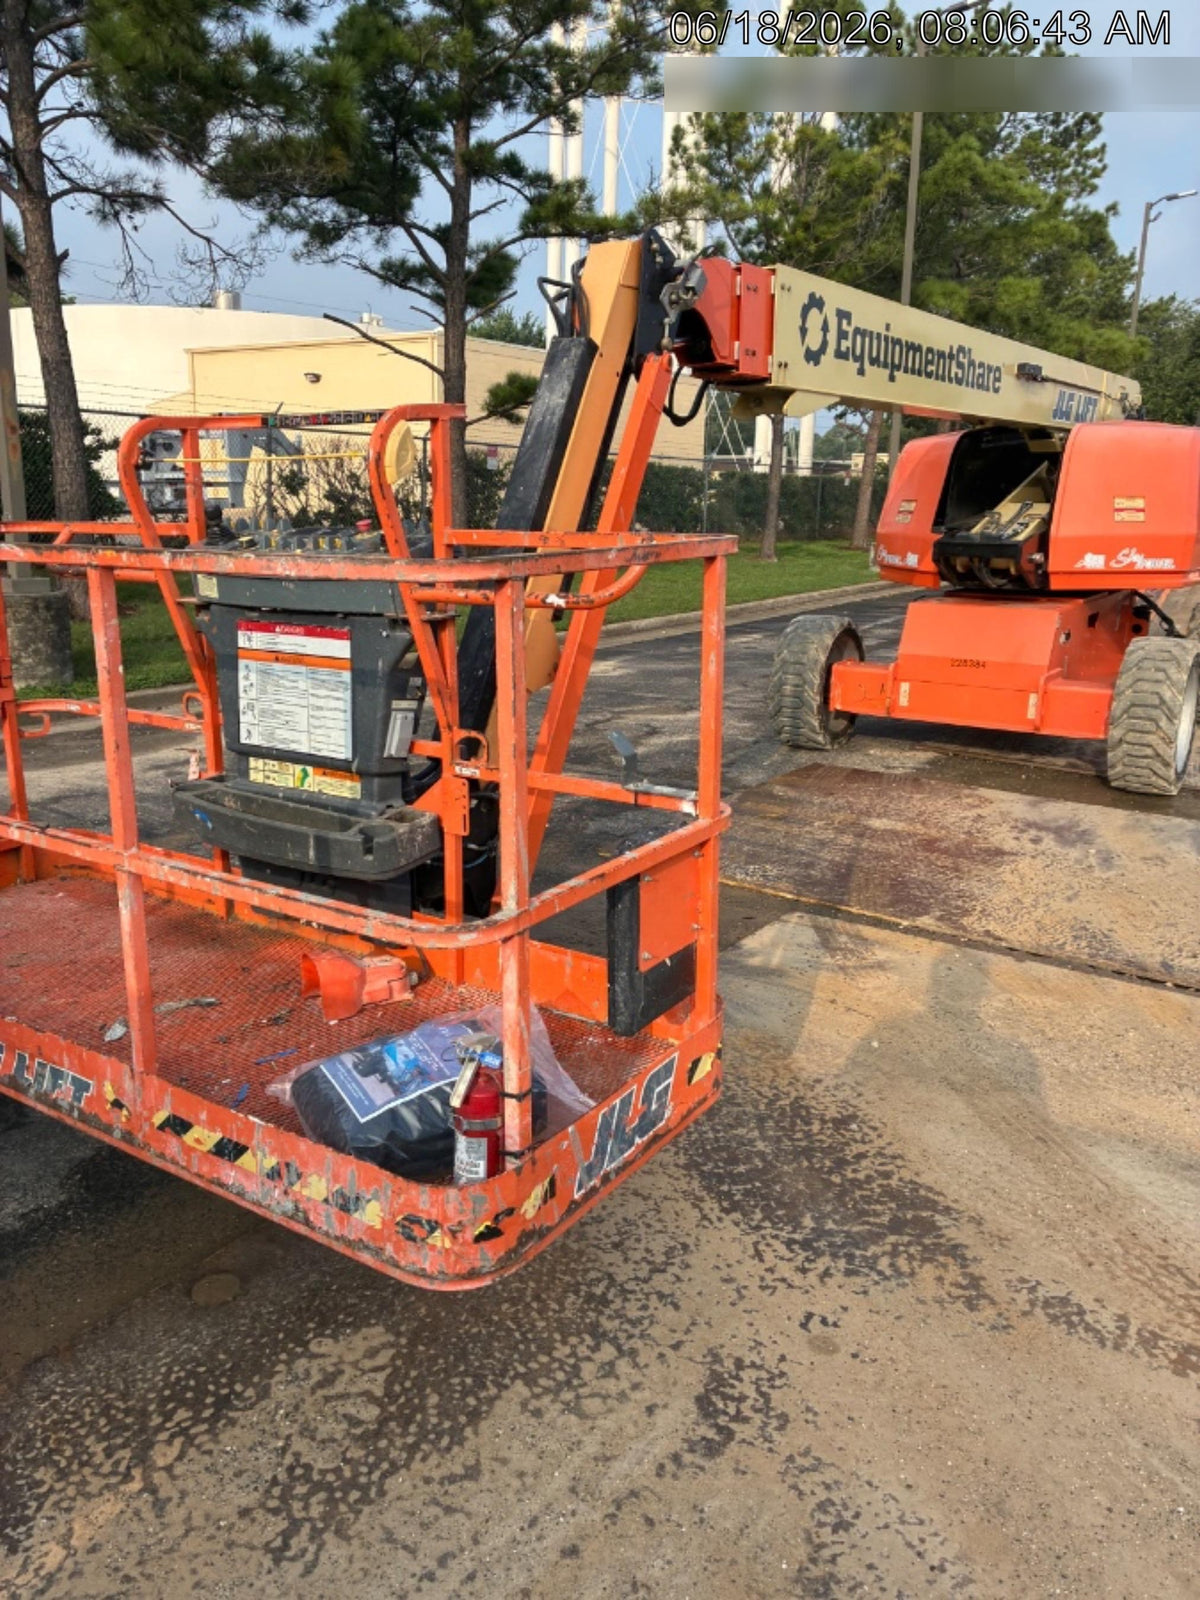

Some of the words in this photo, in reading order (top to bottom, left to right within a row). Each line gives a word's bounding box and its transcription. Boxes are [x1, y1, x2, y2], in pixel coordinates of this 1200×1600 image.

[834, 307, 1002, 394] EquipmentShare
[1052, 389, 1075, 422] JLG
[1074, 393, 1098, 423] LIFT
[12, 1050, 93, 1108] LIFT
[574, 1051, 679, 1199] JLG
